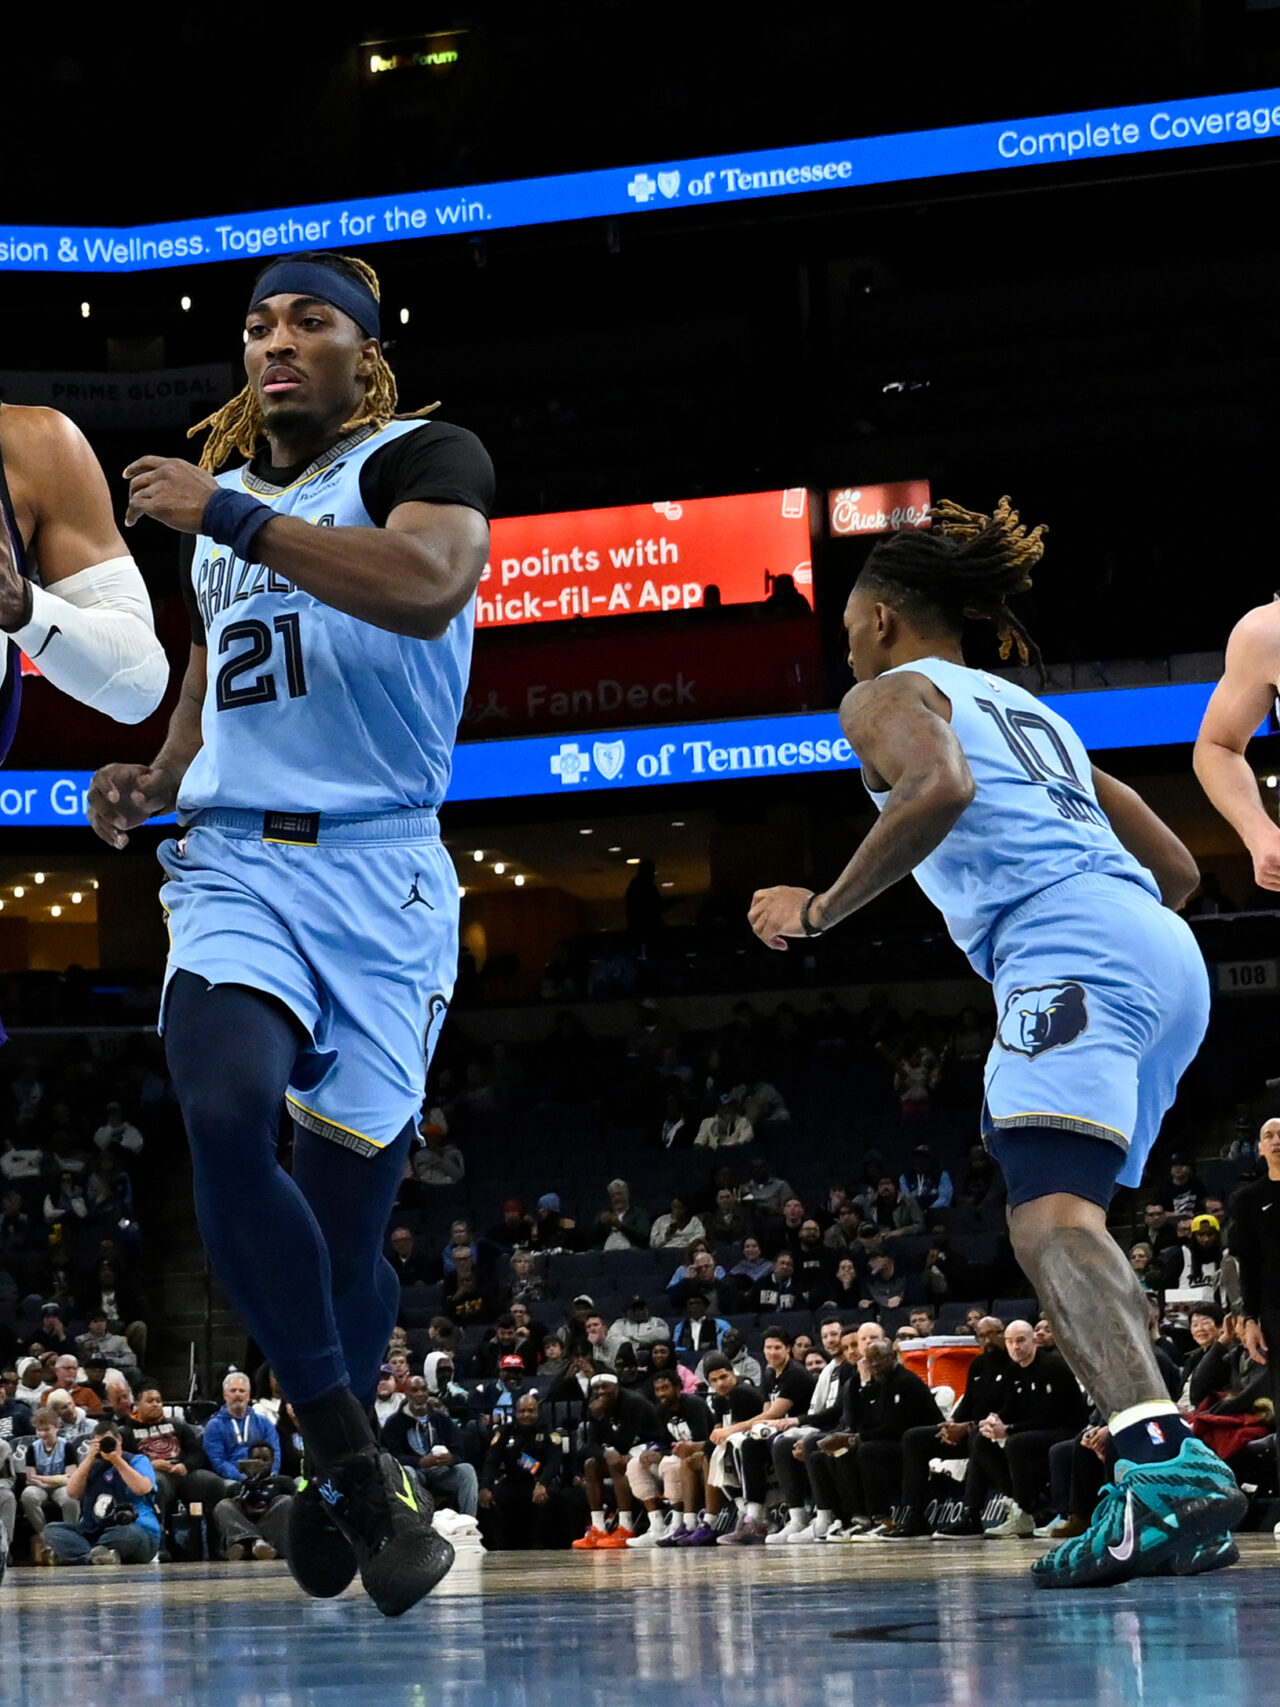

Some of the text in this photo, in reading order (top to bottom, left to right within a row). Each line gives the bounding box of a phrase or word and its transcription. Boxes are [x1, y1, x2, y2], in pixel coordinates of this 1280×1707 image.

[999, 106, 1280, 157] Complete Coverage
[688, 160, 852, 195] of Tennessee
[216, 198, 492, 253] Together for the win.
[57, 238, 78, 262] &
[84, 237, 209, 263] Wellness.
[127, 377, 217, 401] GLOBAL
[502, 546, 599, 586] points
[609, 537, 678, 569] with
[477, 580, 701, 622] hick-fil-A App
[216, 612, 307, 712] 21
[526, 672, 695, 719] FanDeck
[637, 736, 853, 777] of Tennesse
[974, 697, 1089, 794] 10
[1228, 964, 1266, 986] 108
